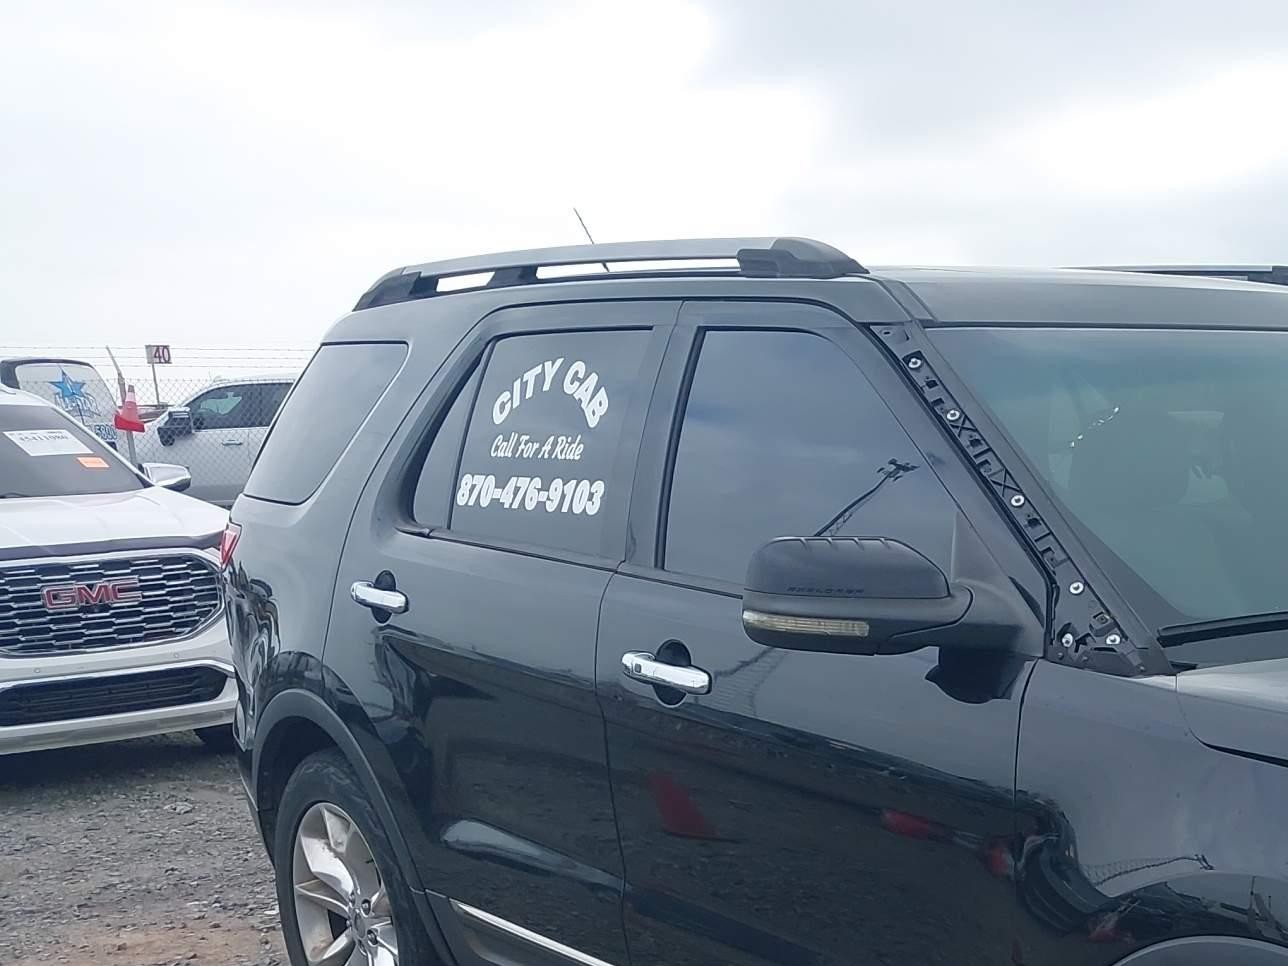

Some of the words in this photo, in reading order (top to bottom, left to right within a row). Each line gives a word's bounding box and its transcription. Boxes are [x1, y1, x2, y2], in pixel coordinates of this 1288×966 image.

[154, 346, 171, 363] 40
[491, 357, 565, 424] CITY
[564, 361, 609, 428] CAB
[491, 432, 518, 458] Call
[516, 434, 540, 459] For
[537, 435, 555, 459] A
[551, 433, 585, 461] Ride
[456, 473, 605, 515] 870-476-9103
[42, 578, 142, 611] GMC
